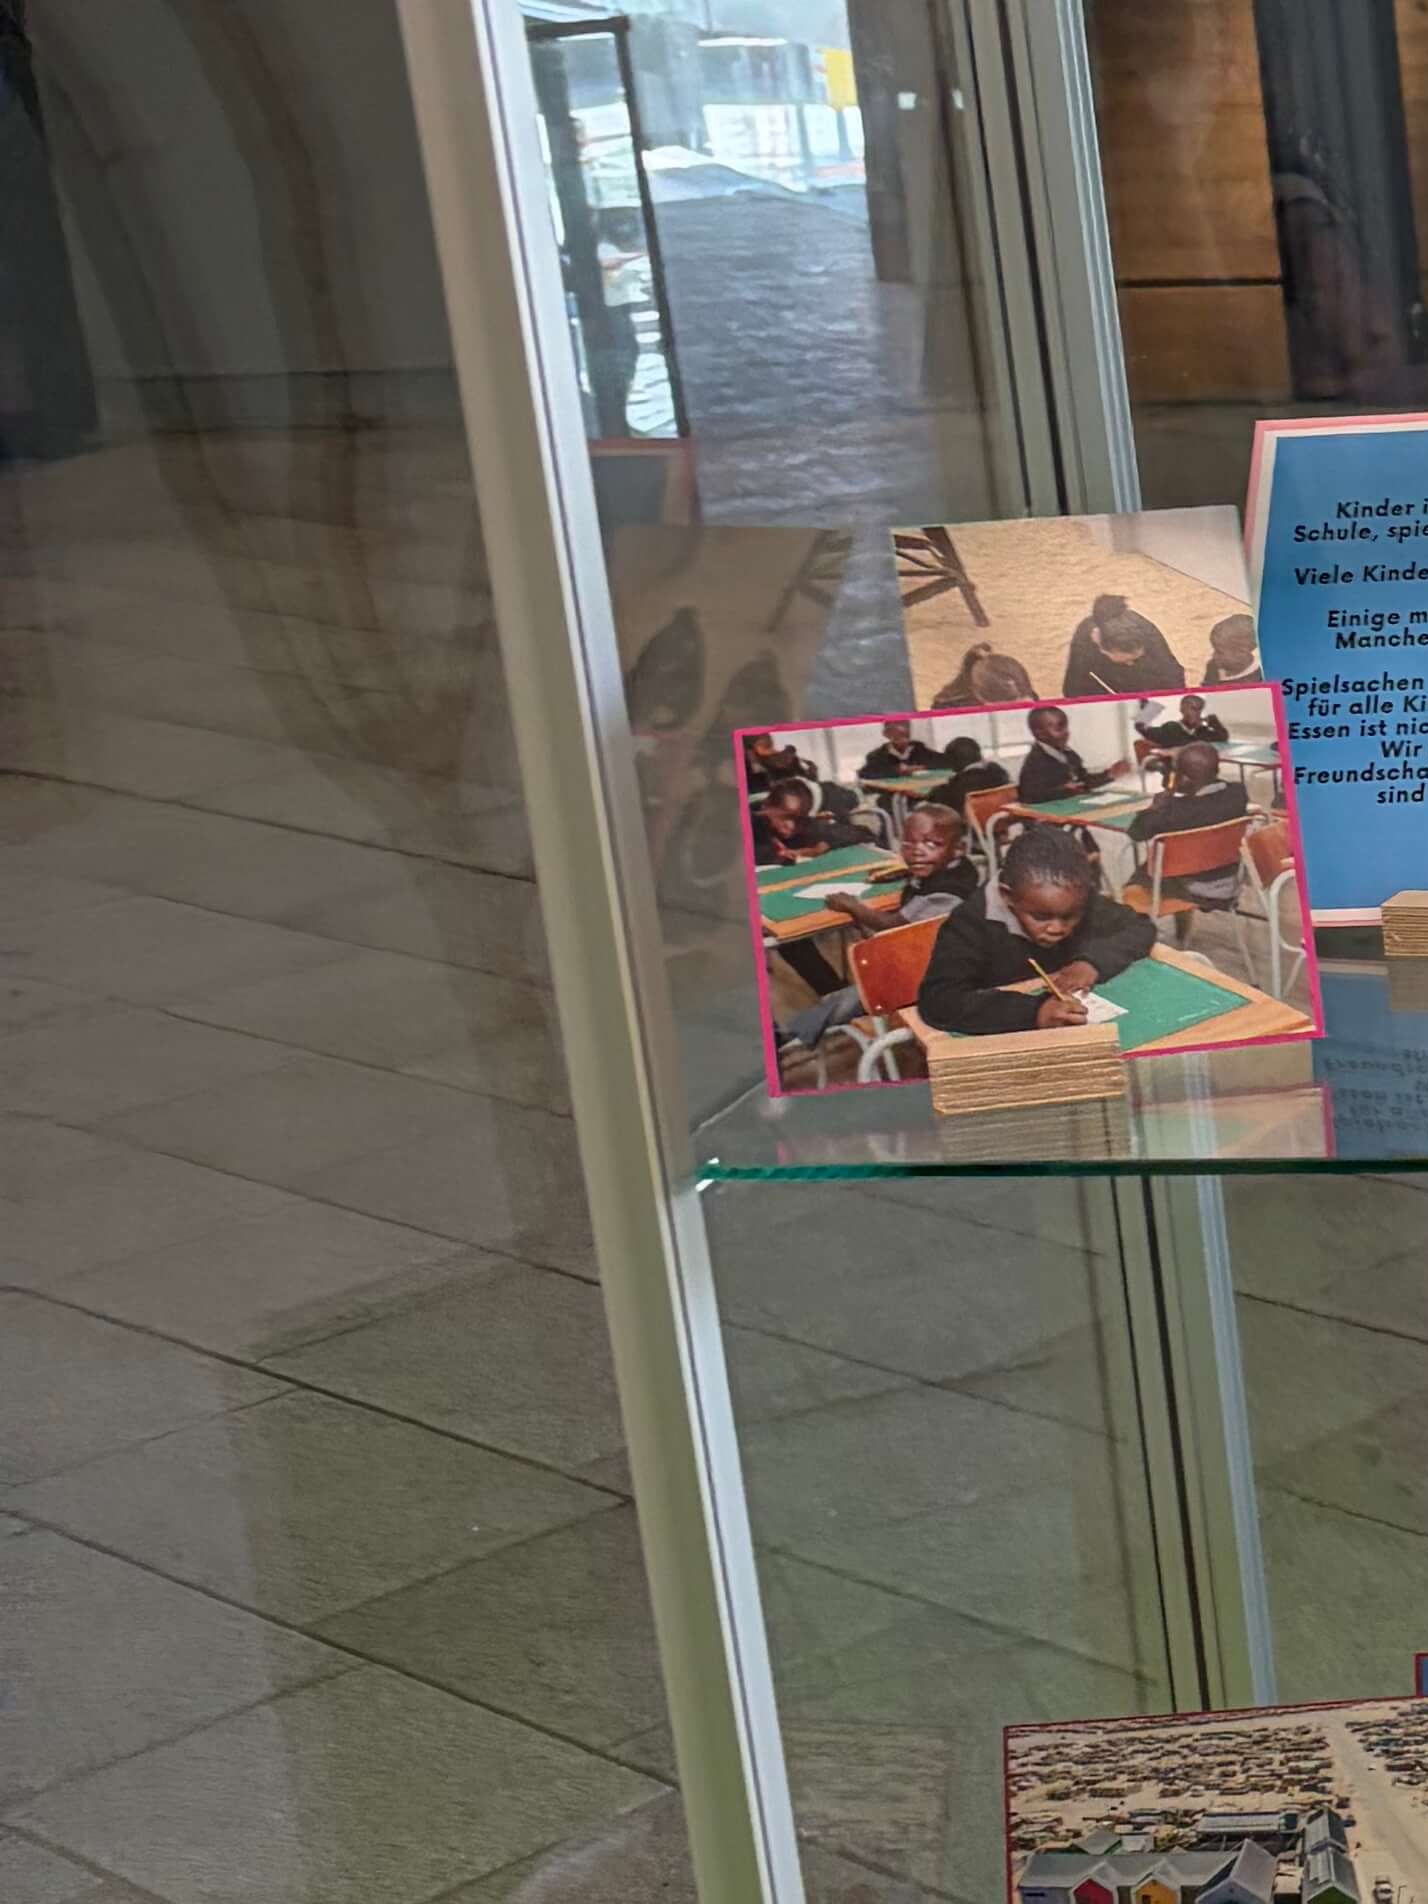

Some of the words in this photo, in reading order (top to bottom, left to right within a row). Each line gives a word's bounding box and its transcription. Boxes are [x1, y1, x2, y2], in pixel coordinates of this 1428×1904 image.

[1335, 497, 1416, 520] Kinder
[1294, 564, 1354, 585] Viele
[1327, 608, 1401, 634] Einige
[1376, 780, 1425, 804] sind
